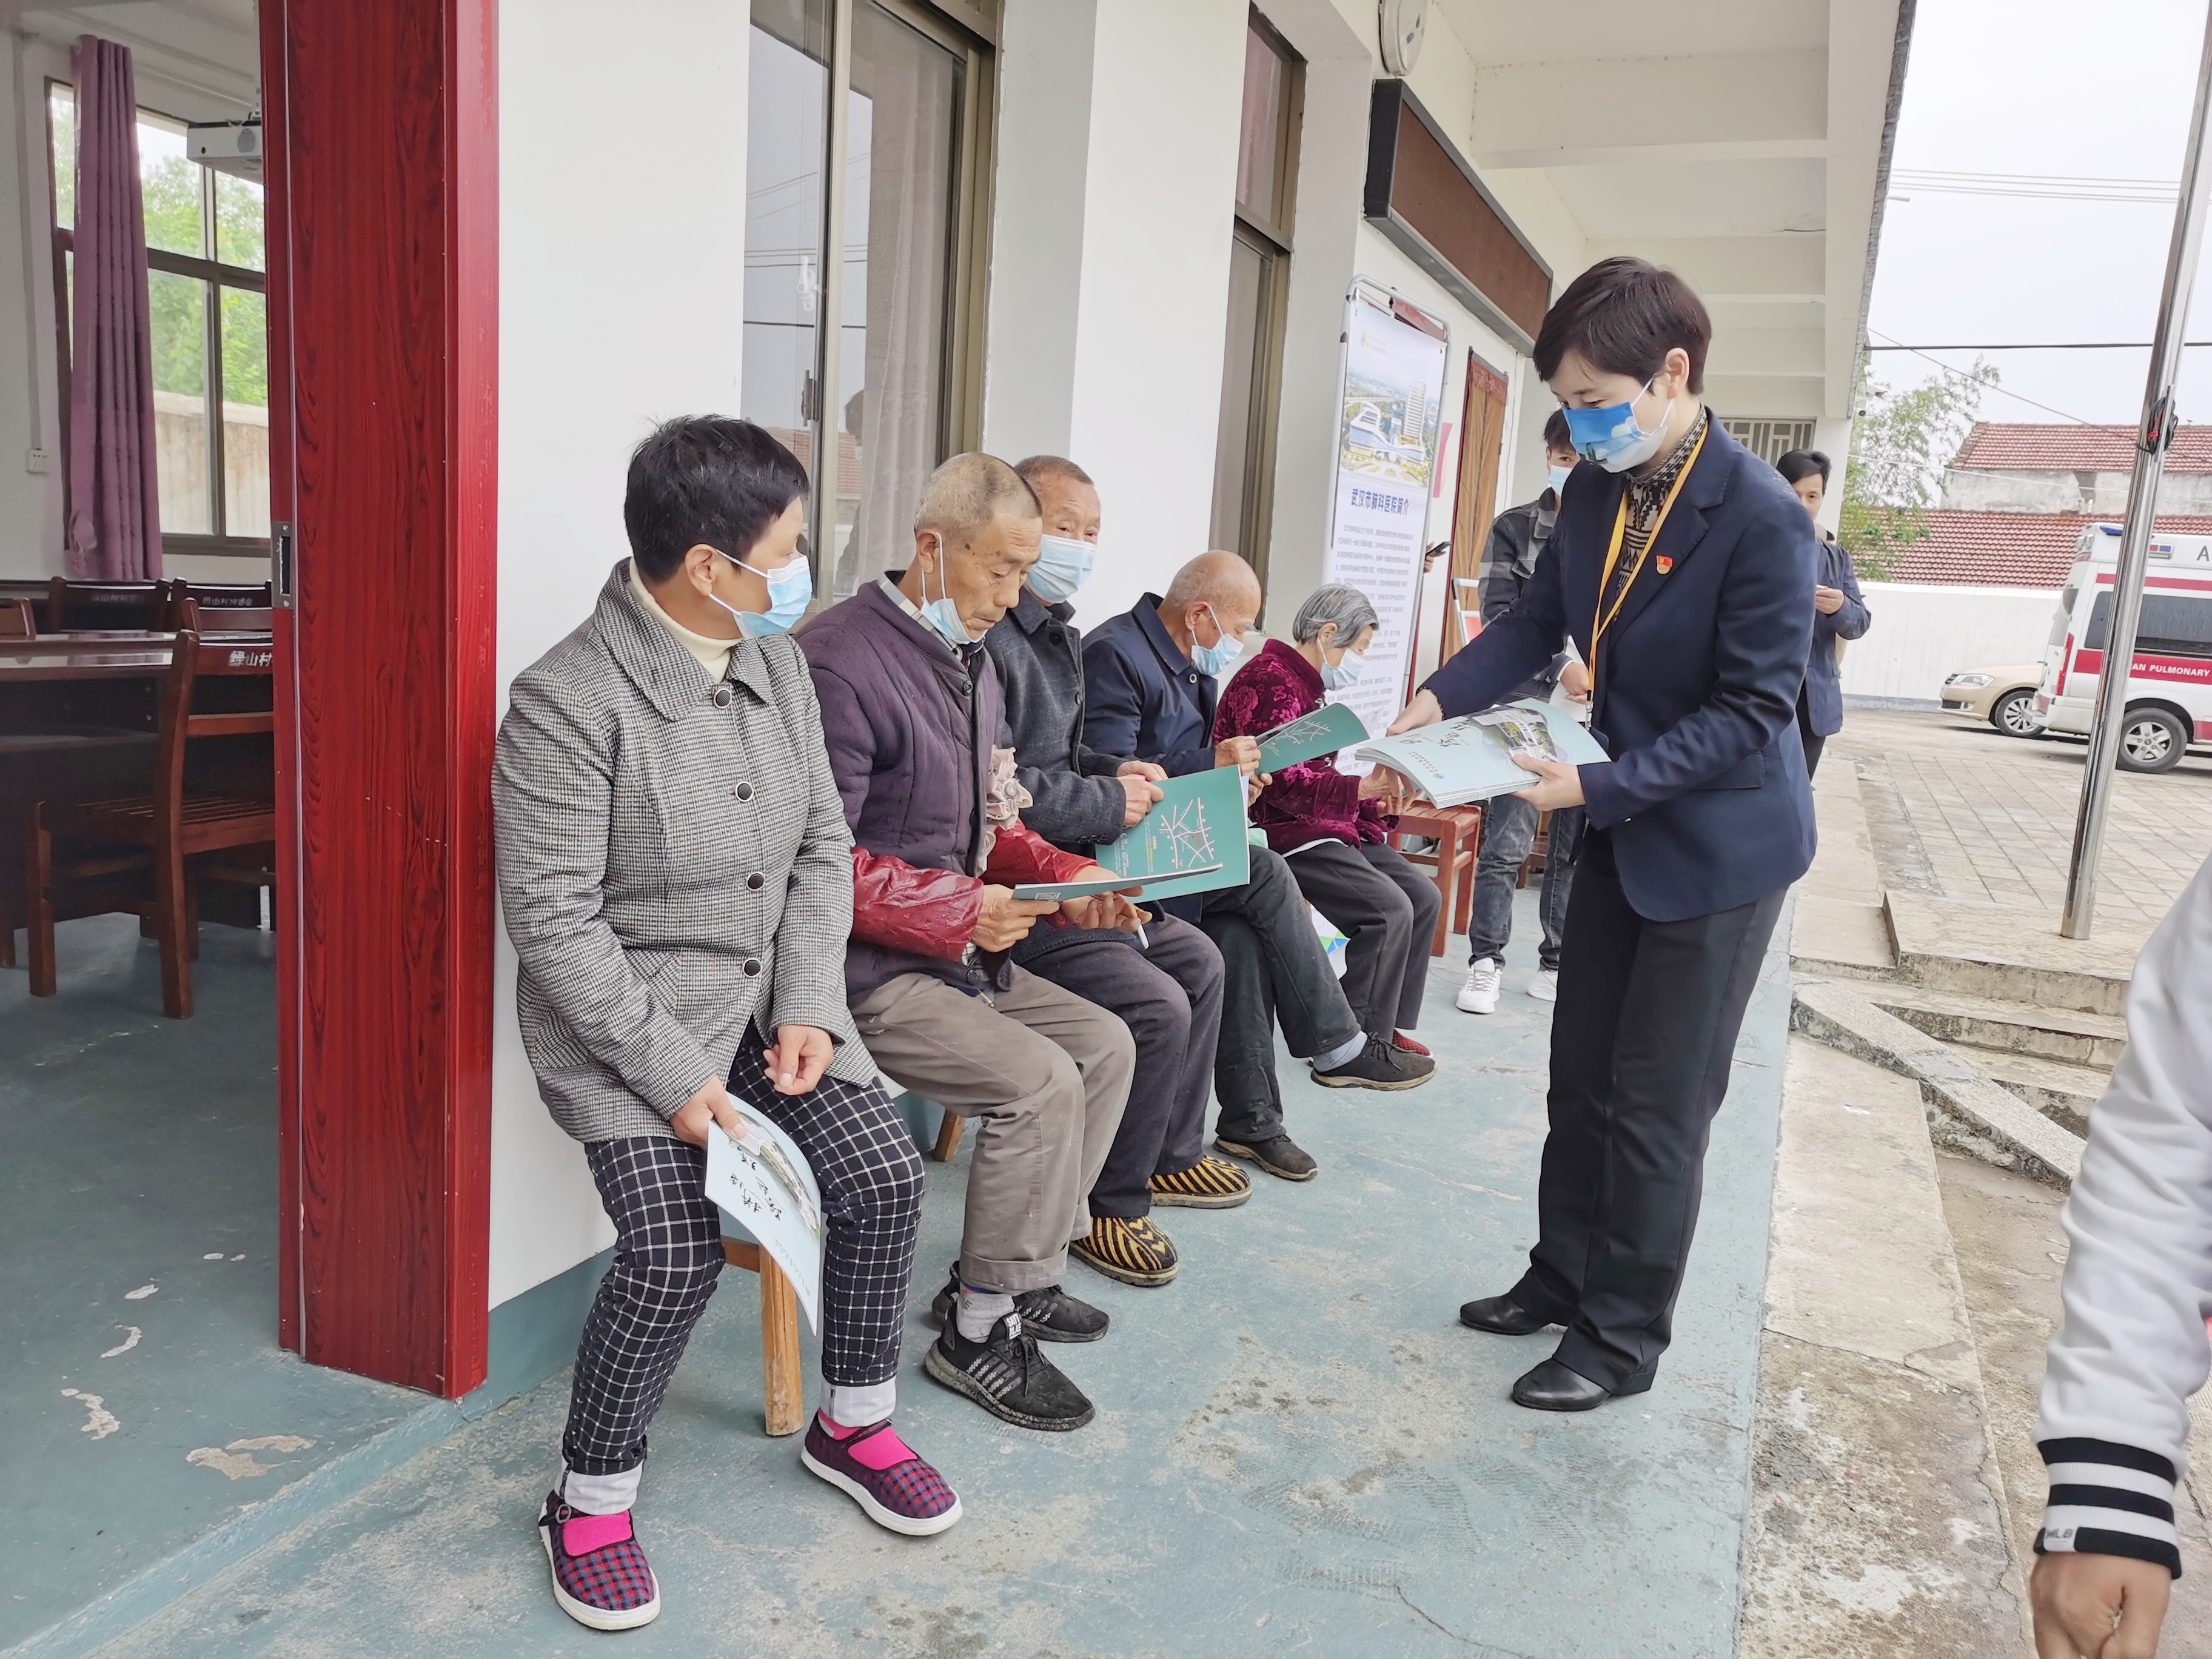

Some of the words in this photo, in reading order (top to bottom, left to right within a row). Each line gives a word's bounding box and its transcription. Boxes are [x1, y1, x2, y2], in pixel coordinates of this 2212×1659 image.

[1351, 488, 1410, 516] 武汉市肺科医院简介
[2149, 664, 2211, 677] PULMONARY
